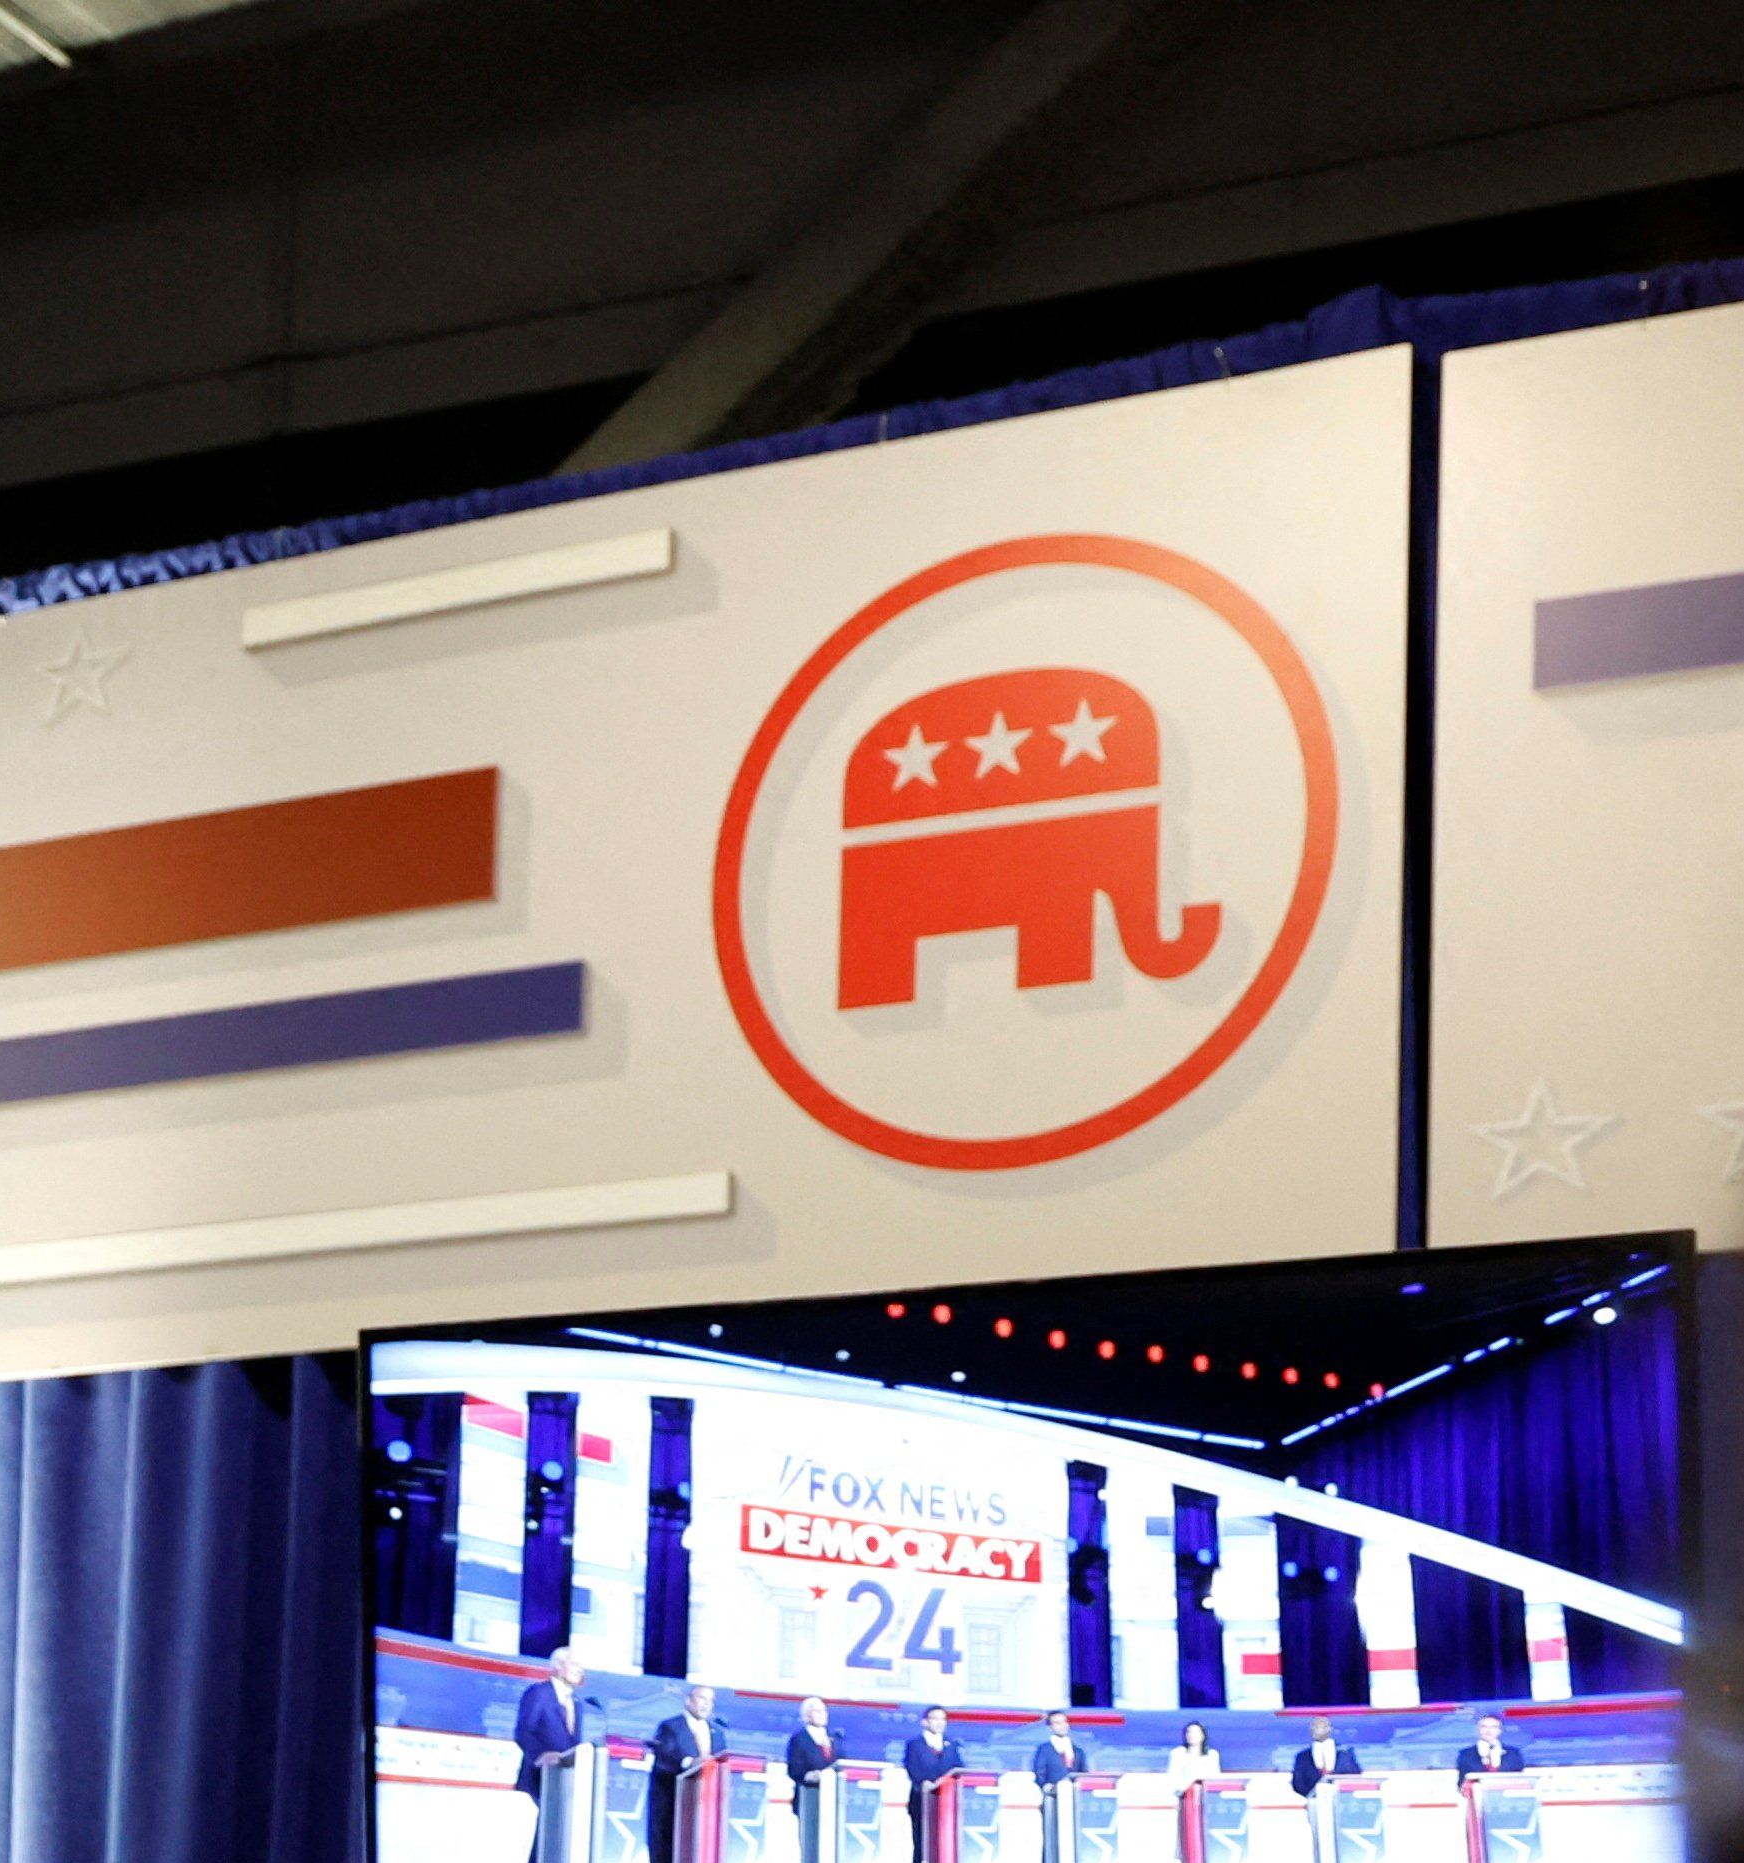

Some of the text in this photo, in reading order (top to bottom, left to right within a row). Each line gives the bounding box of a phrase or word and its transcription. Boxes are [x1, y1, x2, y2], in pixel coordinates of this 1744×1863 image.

[810, 1467, 1008, 1526] FOX NEWS
[748, 1507, 1035, 1580] DEMOCRACY
[844, 1579, 963, 1675] 24
